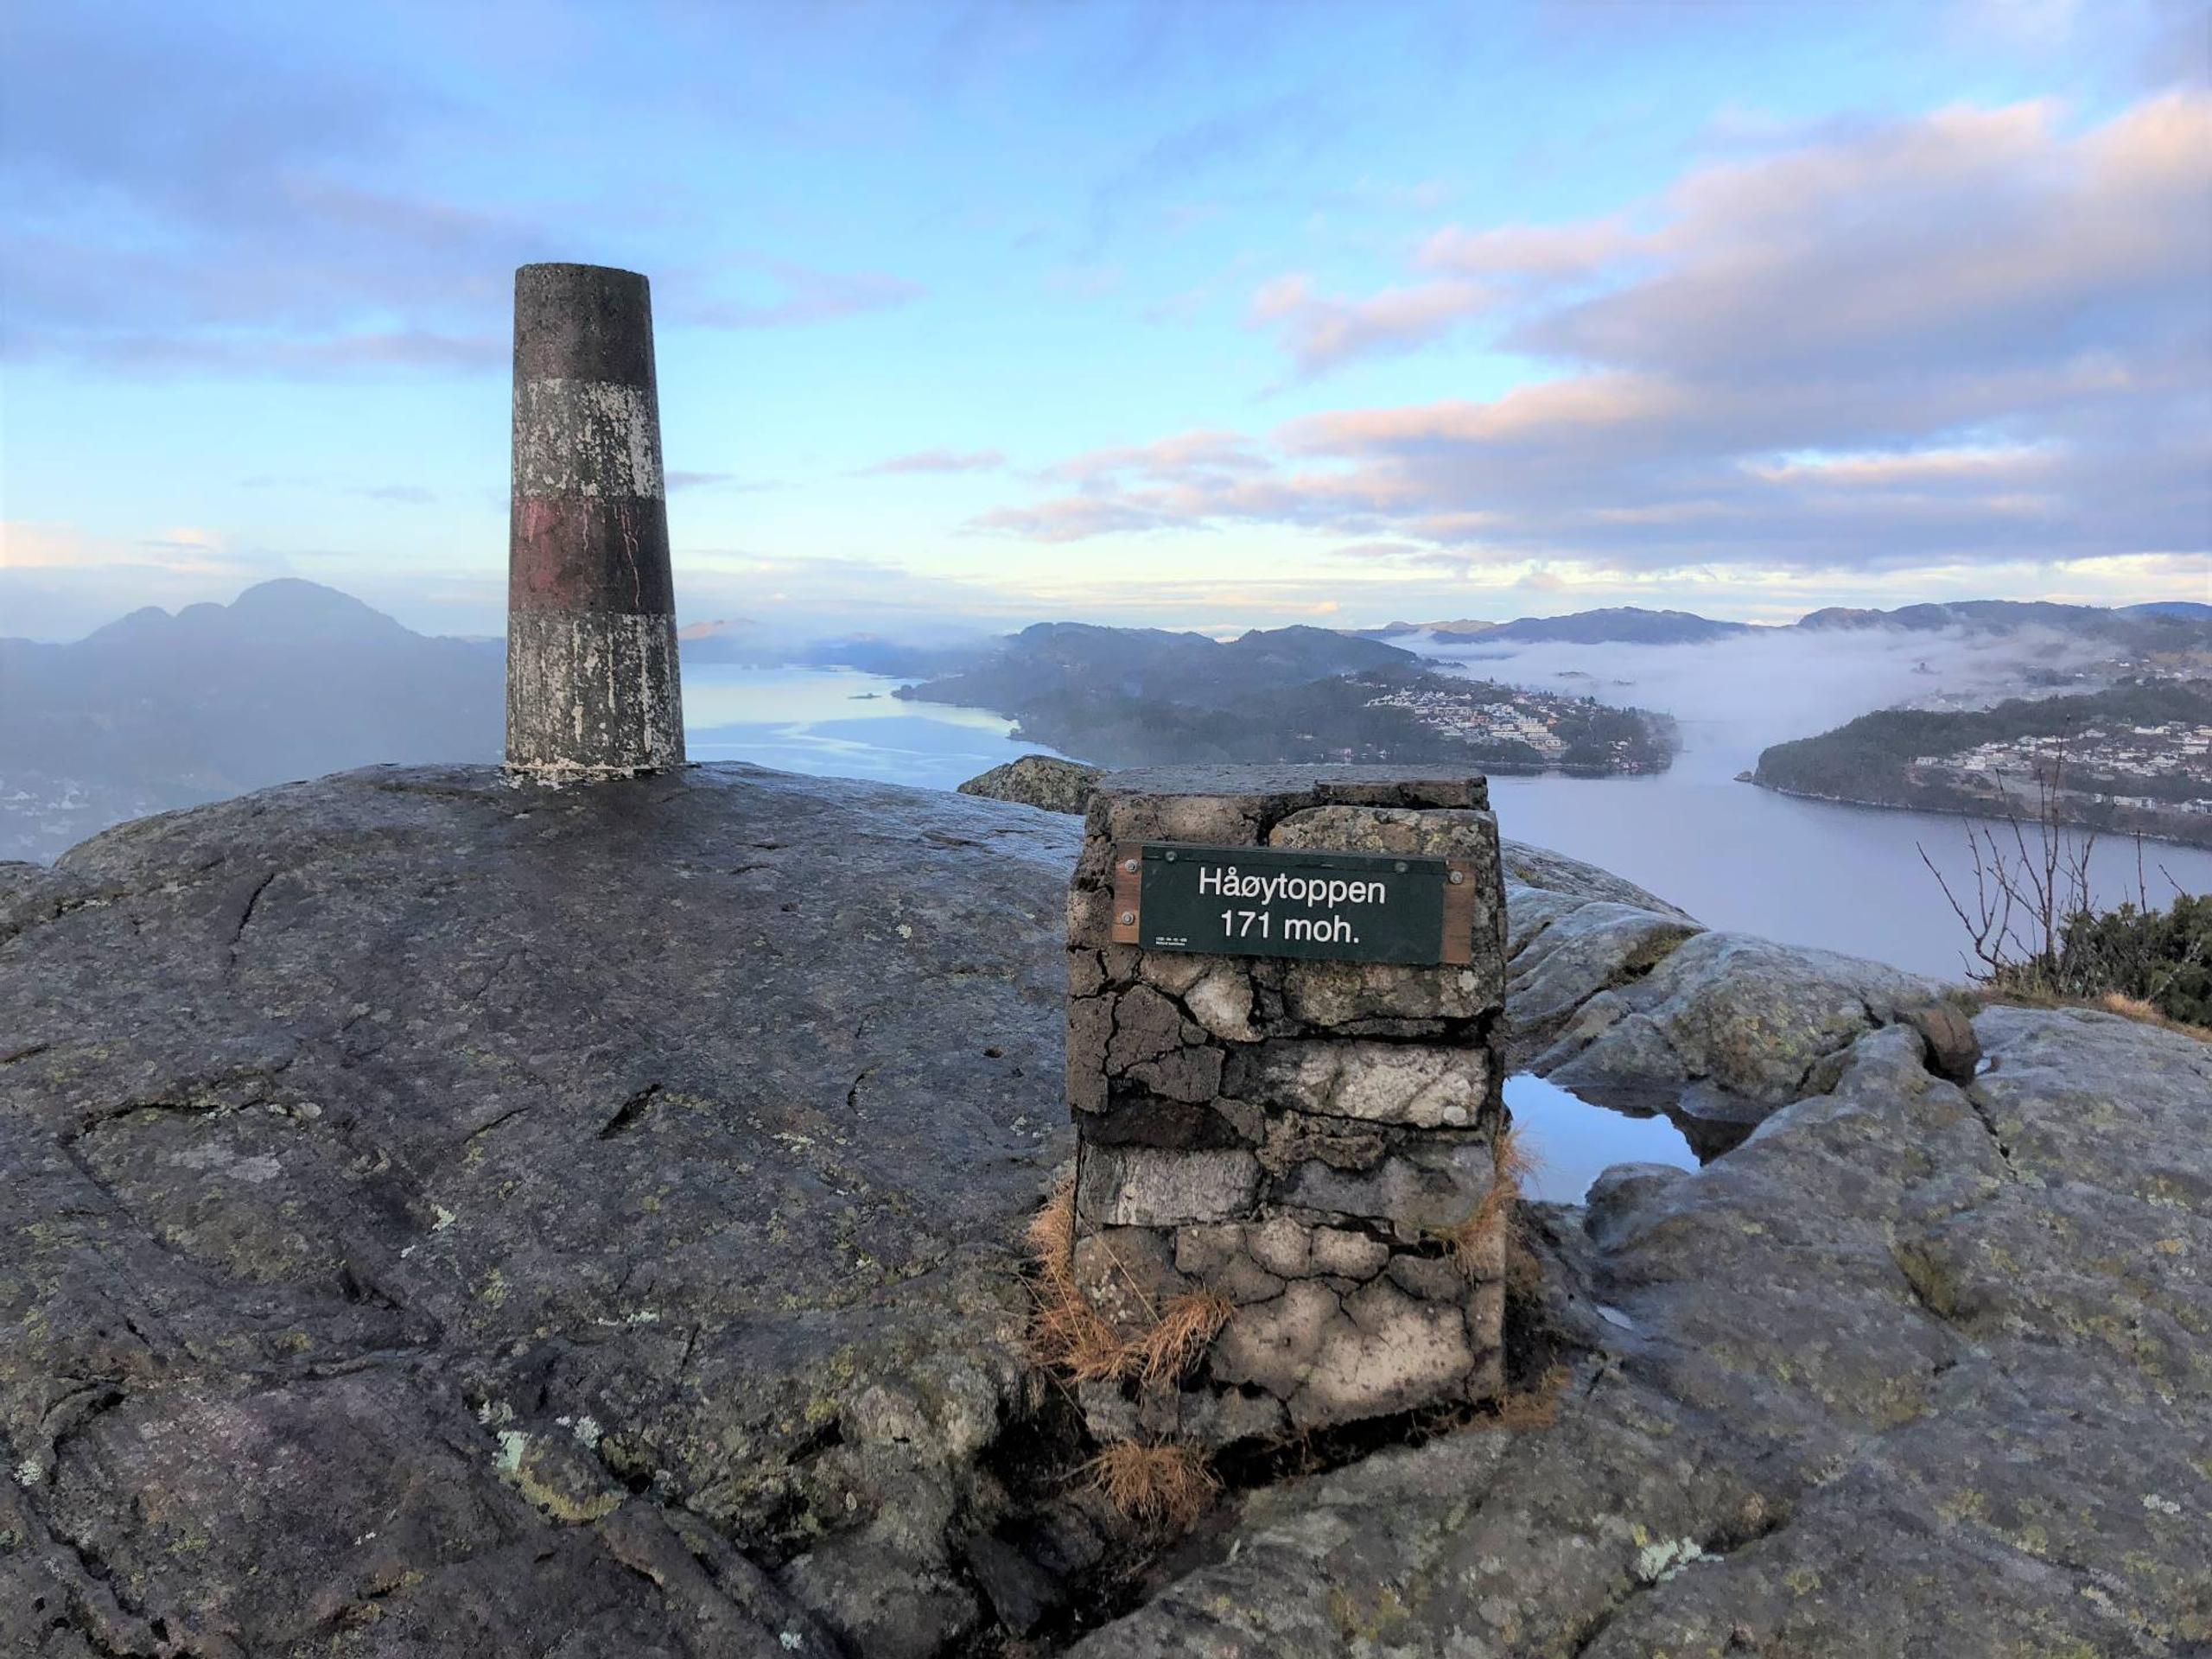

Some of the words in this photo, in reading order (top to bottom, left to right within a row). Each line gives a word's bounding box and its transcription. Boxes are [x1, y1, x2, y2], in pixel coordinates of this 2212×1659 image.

[1199, 867, 1386, 908] Håøytoppen
[1221, 911, 1269, 938] 171
[1284, 915, 1360, 944] moh.
